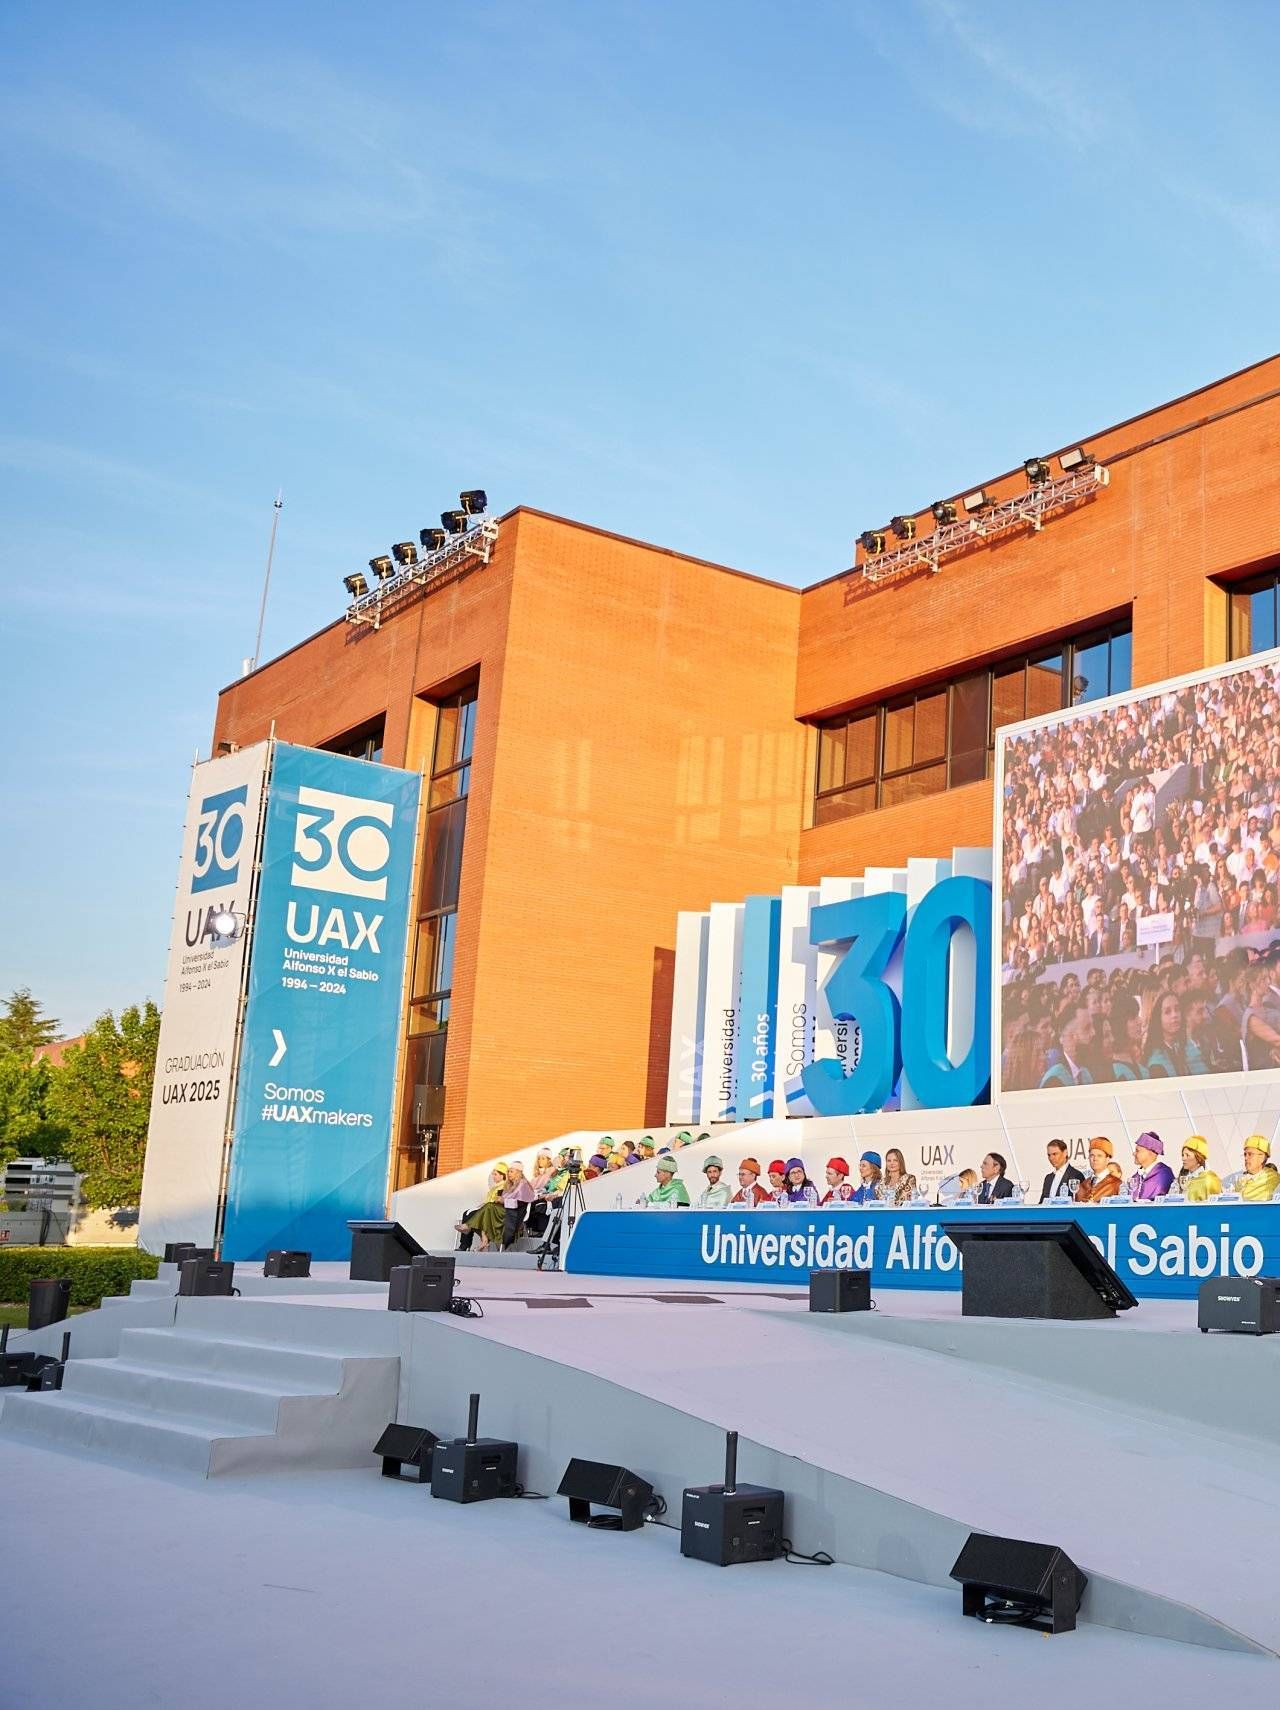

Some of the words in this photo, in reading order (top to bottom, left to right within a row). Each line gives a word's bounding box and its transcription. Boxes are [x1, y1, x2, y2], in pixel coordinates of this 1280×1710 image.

[194, 801, 246, 878] 30
[292, 804, 391, 882] 30
[286, 901, 385, 954] UAX
[282, 960, 326, 975] Alfonso
[327, 965, 336, 976] X
[337, 967, 348, 978] el
[348, 968, 379, 982] Sabio
[284, 947, 349, 966] Universidad
[281, 977, 308, 990] 1994
[319, 981, 347, 995] 2024
[801, 875, 992, 1114] 30
[752, 1013, 770, 1057] años
[786, 1003, 807, 1076] Somos
[719, 1009, 735, 1101] Universidad
[751, 1060, 768, 1083] 30
[162, 1083, 188, 1105] UAX
[189, 1079, 221, 1102] 2025
[263, 1082, 325, 1103] Somos
[261, 1104, 373, 1127] #UAXmakers
[921, 1144, 954, 1166] UAX
[701, 1224, 875, 1269] Universidad
[885, 1224, 963, 1272] Alfo
[1127, 1223, 1264, 1277] Sabio
